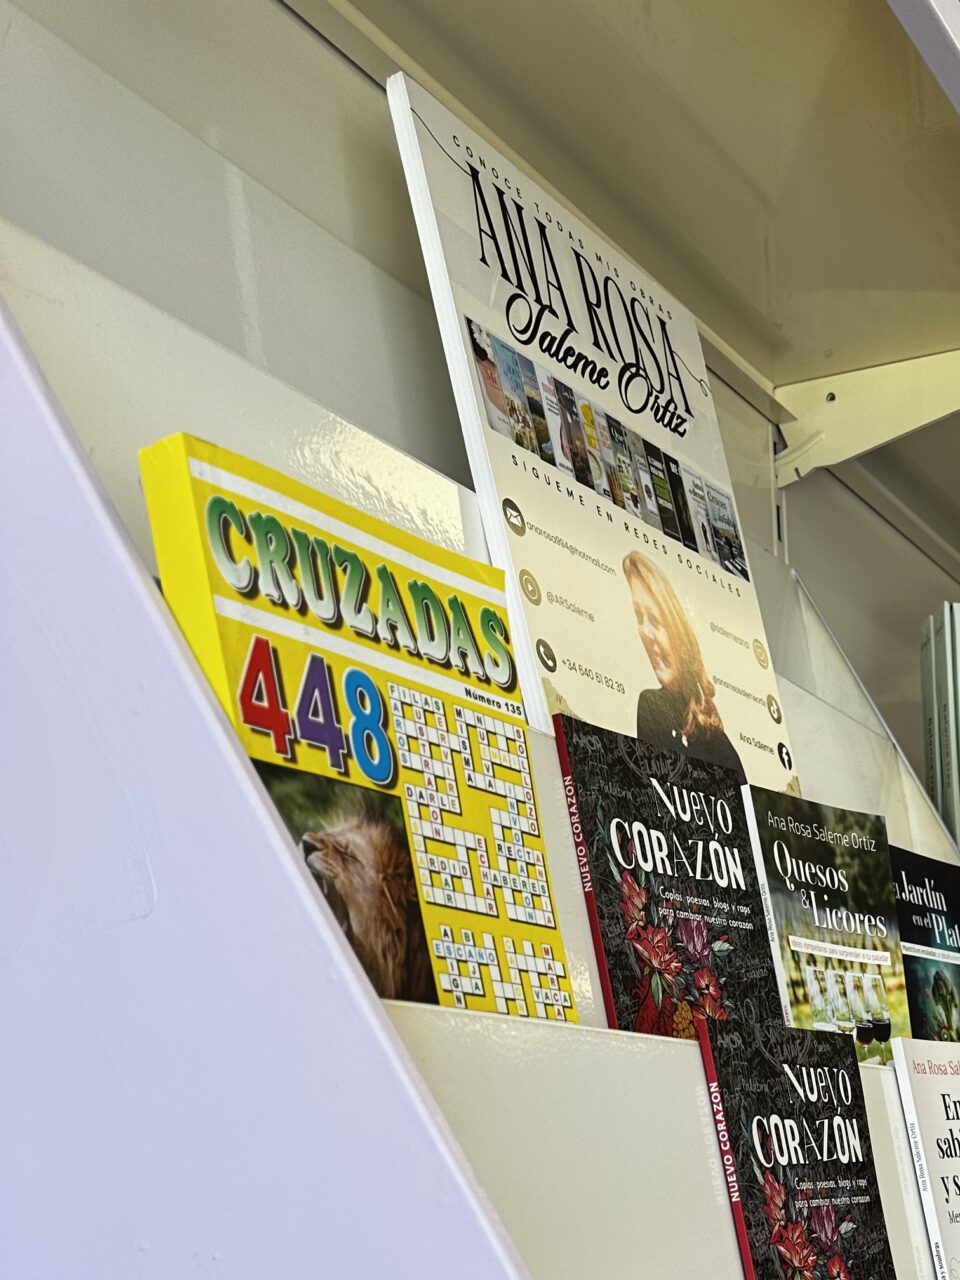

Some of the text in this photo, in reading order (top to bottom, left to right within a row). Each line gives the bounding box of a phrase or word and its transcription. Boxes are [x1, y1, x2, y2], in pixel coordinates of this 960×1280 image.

[452, 135, 672, 320] CONOCE TODAS MIS OBRAS
[466, 161, 695, 419] ANA ROSA
[505, 293, 687, 438] Saleme Ortiz
[511, 454, 742, 598] SIGUEME EN REDES SOCIALES
[206, 494, 517, 692] CRUZADAS
[239, 635, 394, 785] 448
[464, 687, 522, 716] Número 135
[563, 775, 593, 892] NUEVO CORAZON
[610, 817, 747, 891] CORAZÓN
[768, 810, 877, 852] Ana Rosa Saleme Ortiz
[773, 840, 849, 892] Quesos
[900, 870, 948, 912] Jardín
[658, 907, 675, 917] para
[704, 914, 727, 926] nuestro
[800, 889, 888, 938] & Licores
[912, 913, 924, 927] en
[923, 912, 931, 928] el
[912, 1059, 926, 1075] Ana
[927, 1059, 949, 1076] Rosa
[709, 1081, 741, 1202] NUEVO CORAZON
[752, 1107, 864, 1168] CORAZÓN
[941, 1175, 952, 1204] y
